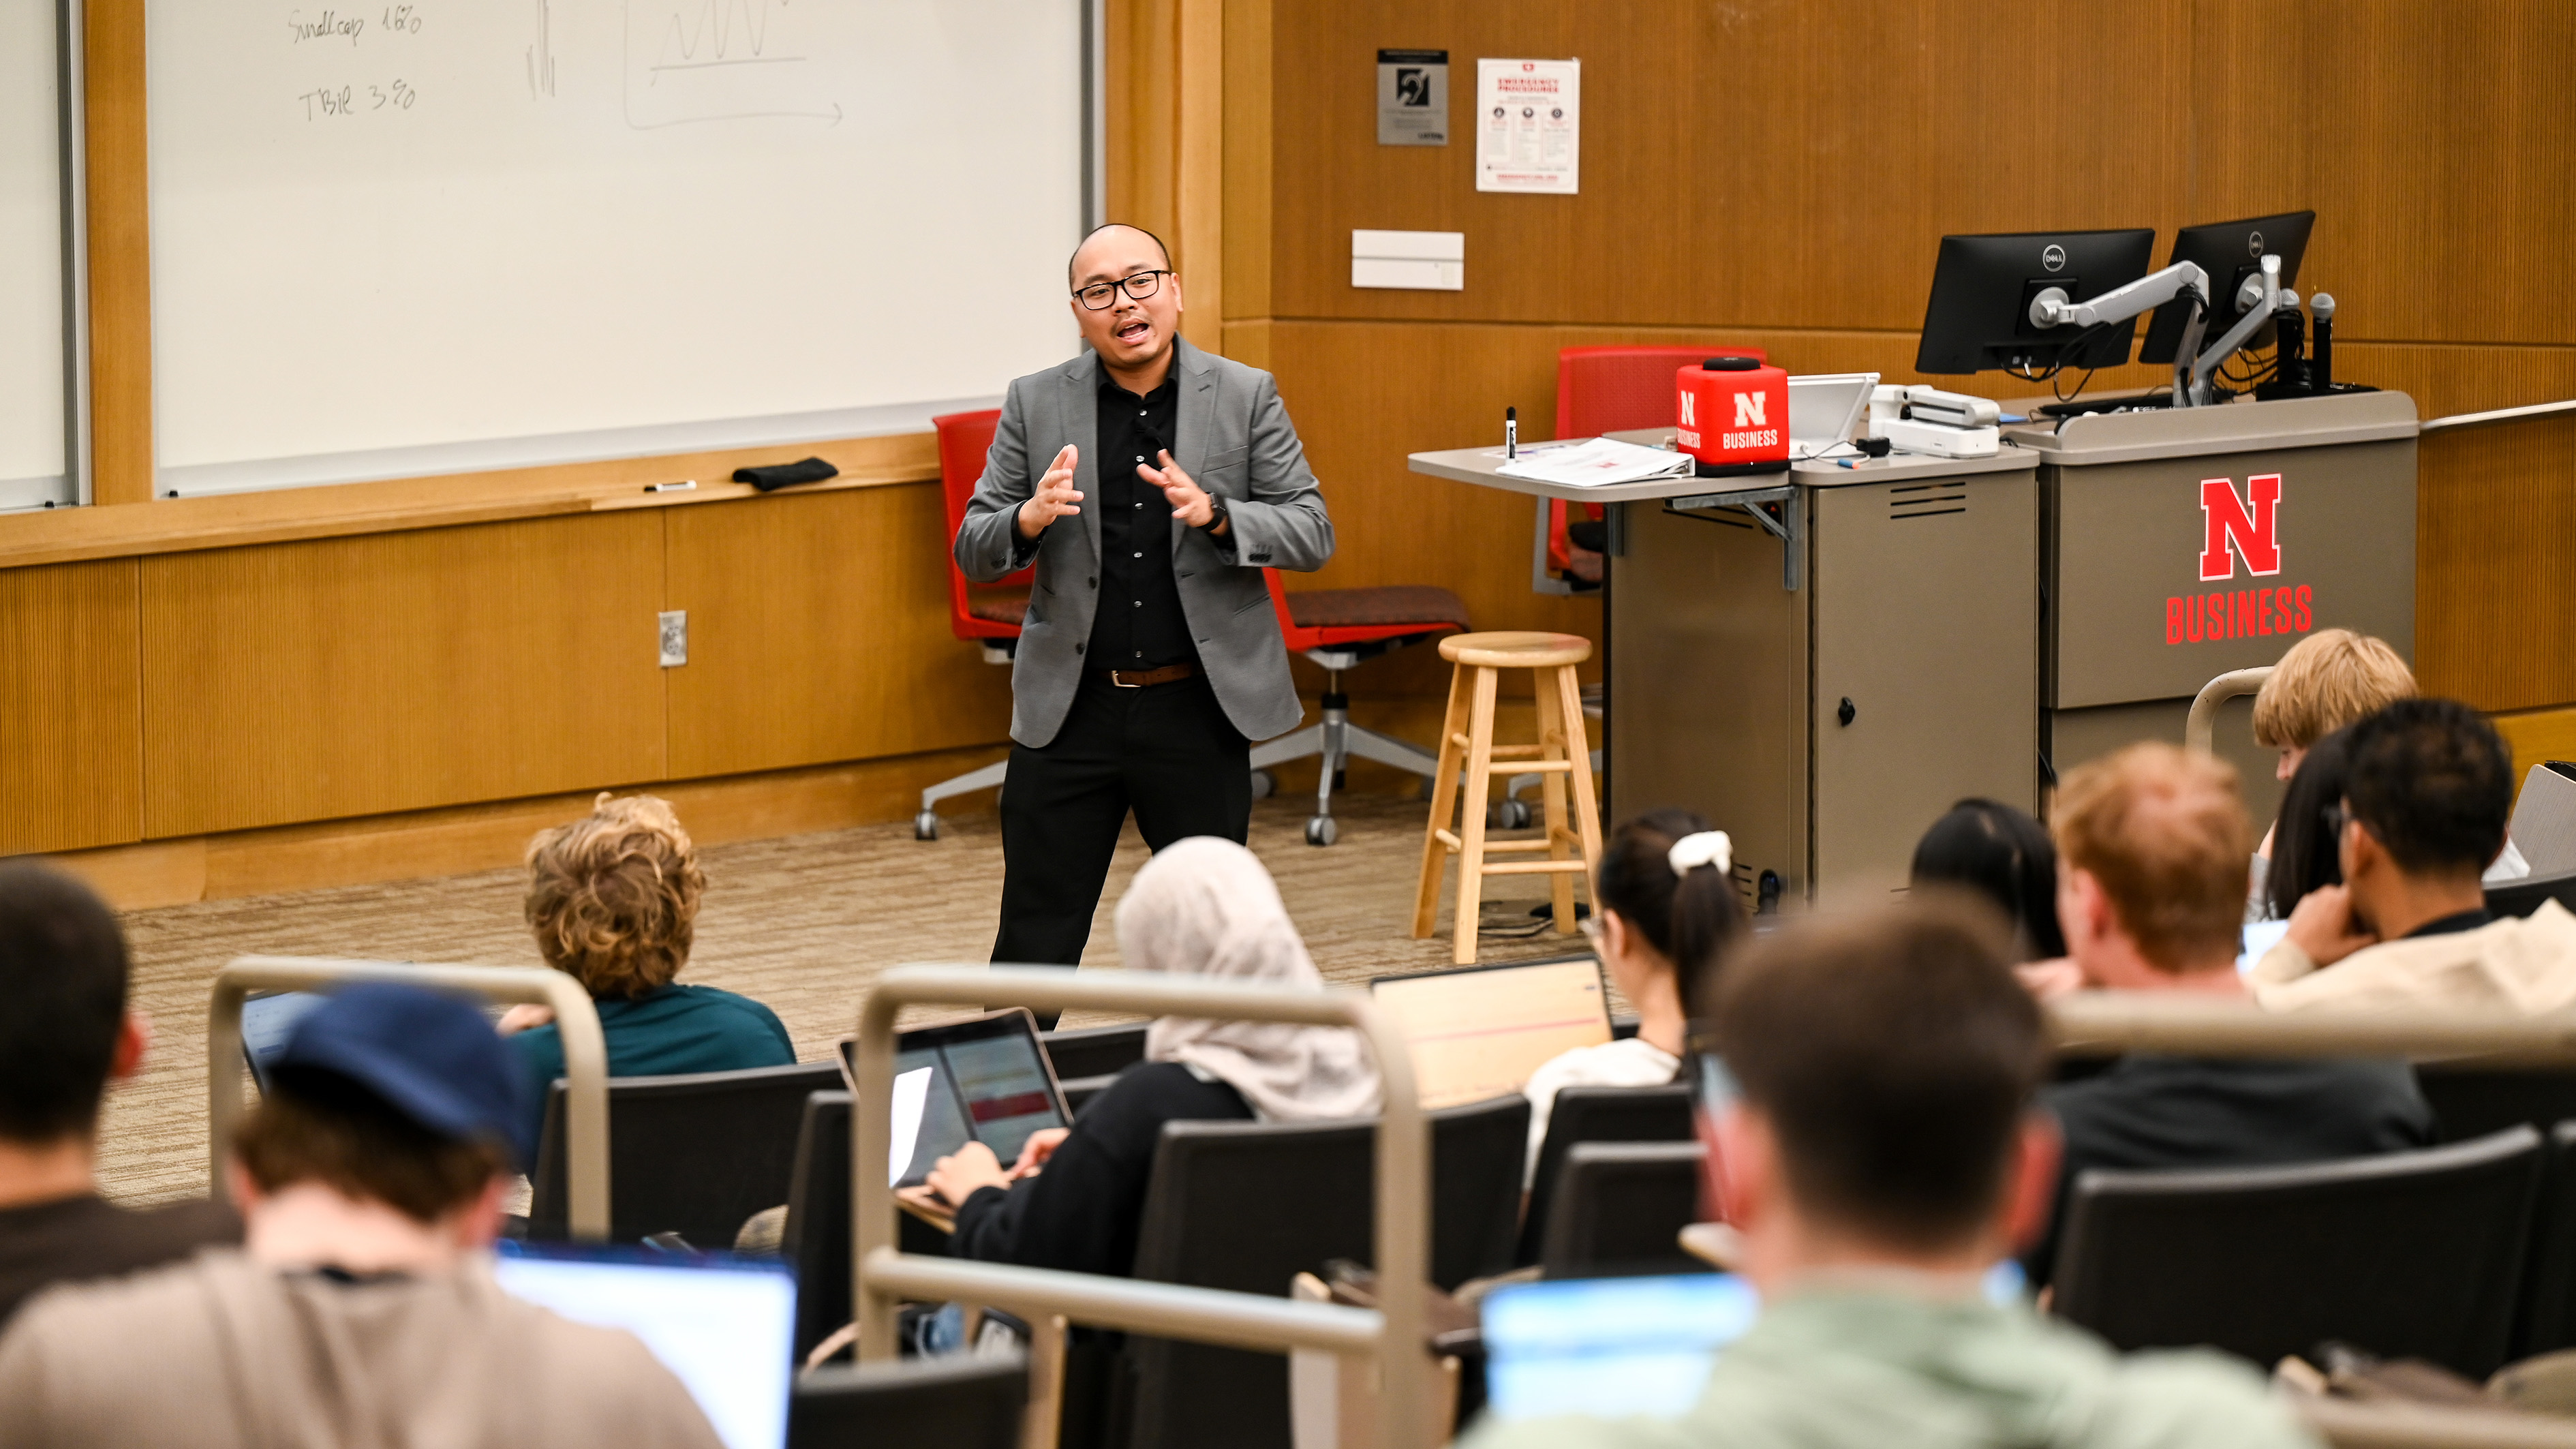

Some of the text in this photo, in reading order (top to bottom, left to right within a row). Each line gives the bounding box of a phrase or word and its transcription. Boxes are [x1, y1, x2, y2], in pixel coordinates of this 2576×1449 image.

[2045, 254, 2063, 263] DELL
[1681, 389, 1696, 428] N
[1733, 391, 1767, 428] N
[1677, 427, 1701, 450] BUSINESS
[1723, 429, 1778, 450] BUSINESS
[2200, 473, 2282, 581] N
[2166, 584, 2312, 645] BUSINESS
